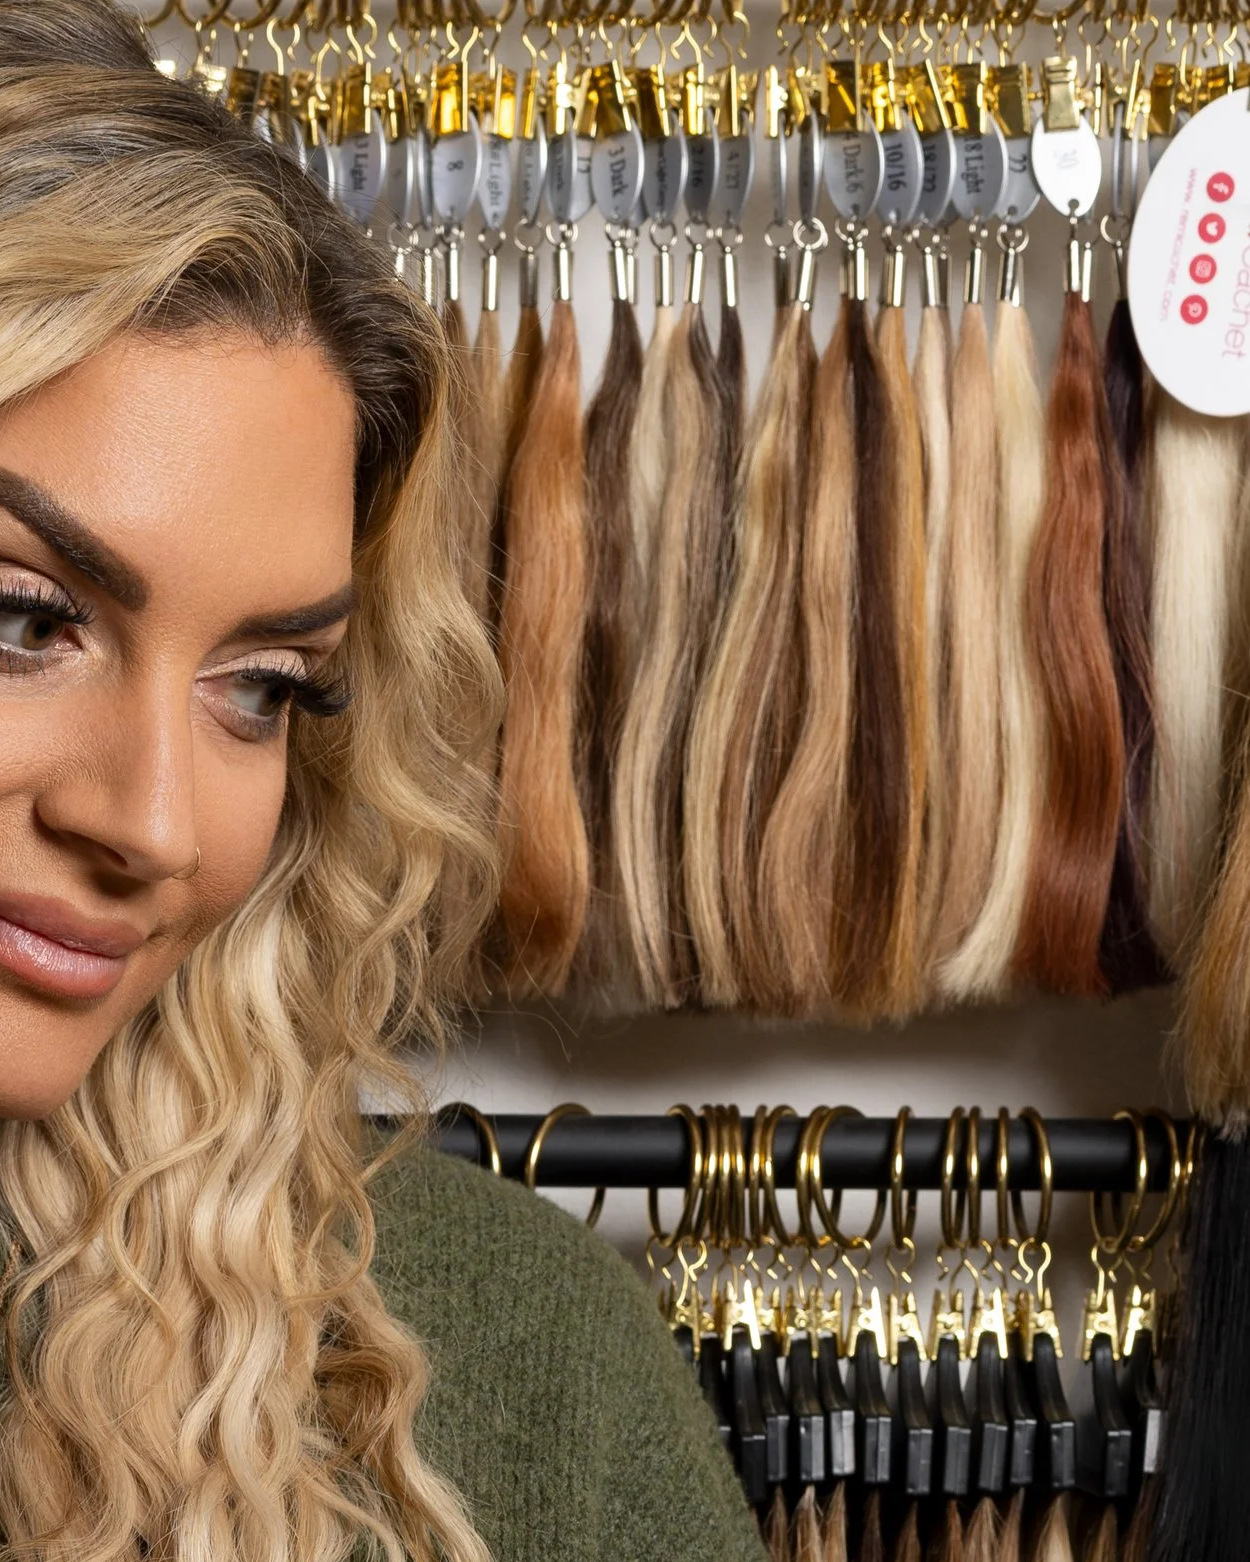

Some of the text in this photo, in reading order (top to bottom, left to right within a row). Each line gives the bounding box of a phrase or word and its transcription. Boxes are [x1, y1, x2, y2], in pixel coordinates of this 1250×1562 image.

[610, 158, 630, 198] Dark
[885, 143, 907, 192] 10/16
[960, 155, 986, 194] Light
